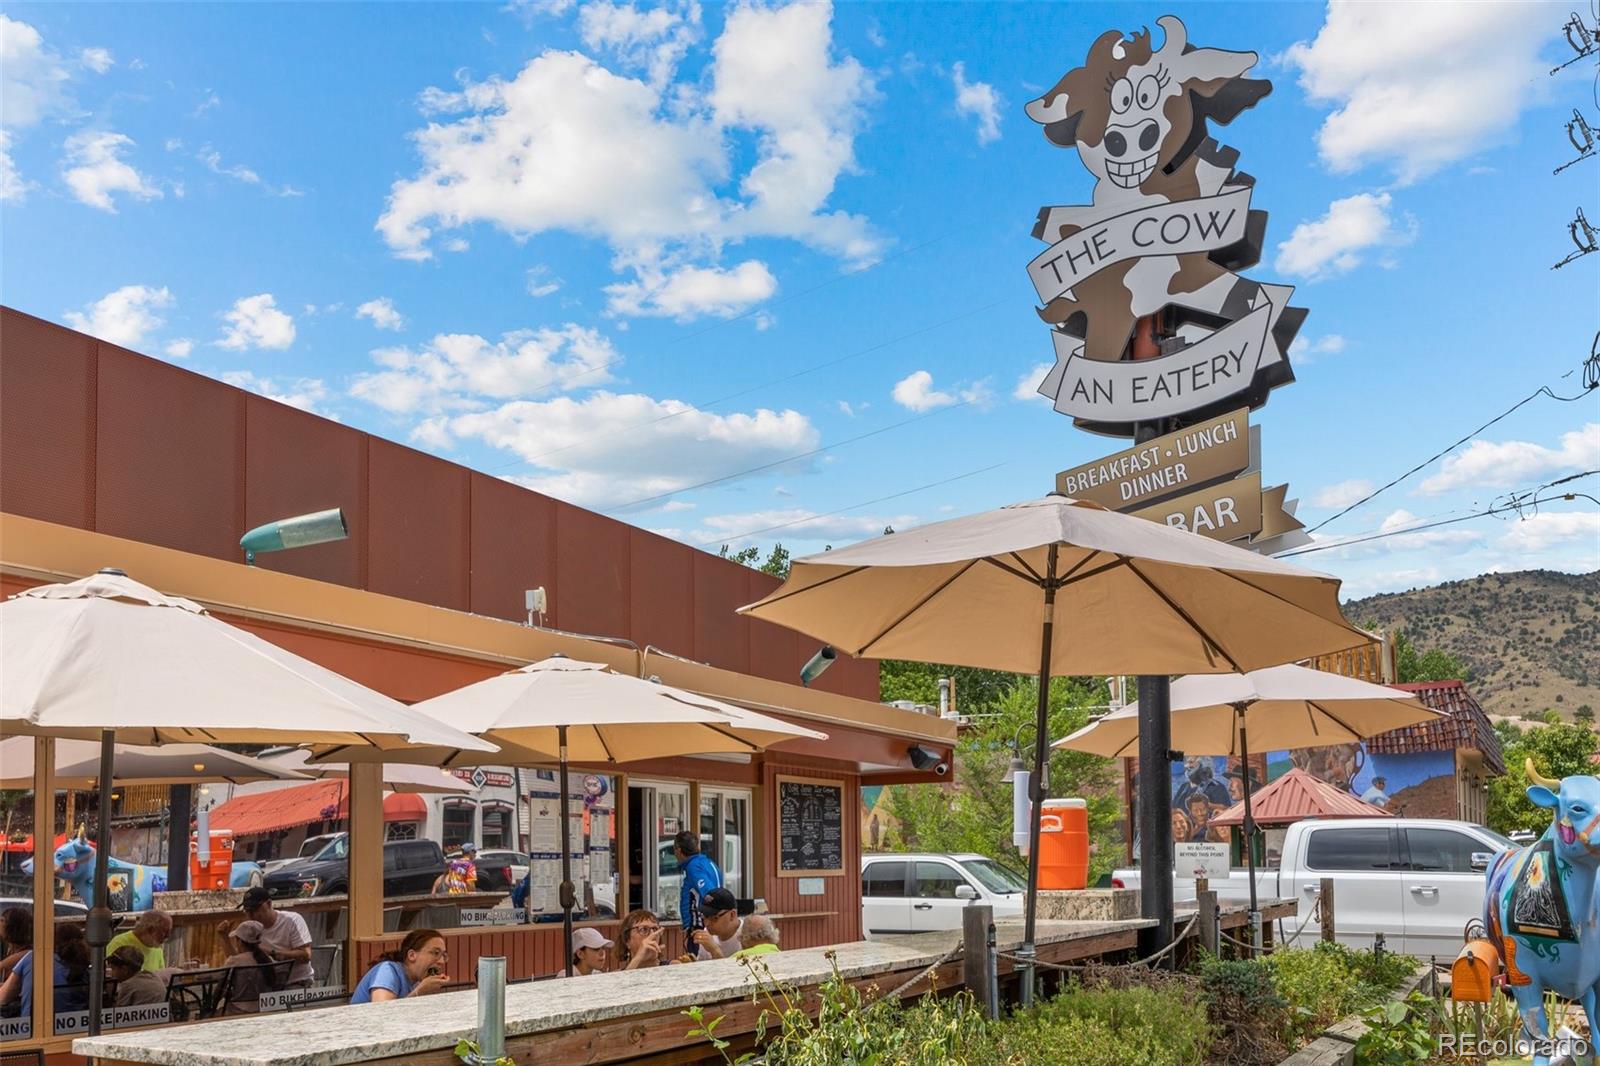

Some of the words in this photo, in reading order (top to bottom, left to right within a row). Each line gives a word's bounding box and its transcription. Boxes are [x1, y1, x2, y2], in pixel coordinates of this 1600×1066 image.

[1040, 228, 1116, 284] THE
[1132, 208, 1236, 248] COW
[1070, 377, 1113, 404] AN
[1132, 342, 1249, 404] EATERY
[1065, 446, 1160, 496] BREAKFAST
[1177, 419, 1238, 458] LUNCH
[1119, 463, 1188, 502] DINNER
[1166, 497, 1240, 534] BAR
[461, 913, 473, 921] NO
[56, 1017, 76, 1029] NO
[81, 1013, 113, 1027] BKE
[115, 1007, 168, 1023] PARKING
[260, 996, 276, 1008] NO
[280, 992, 303, 1005] BIKE
